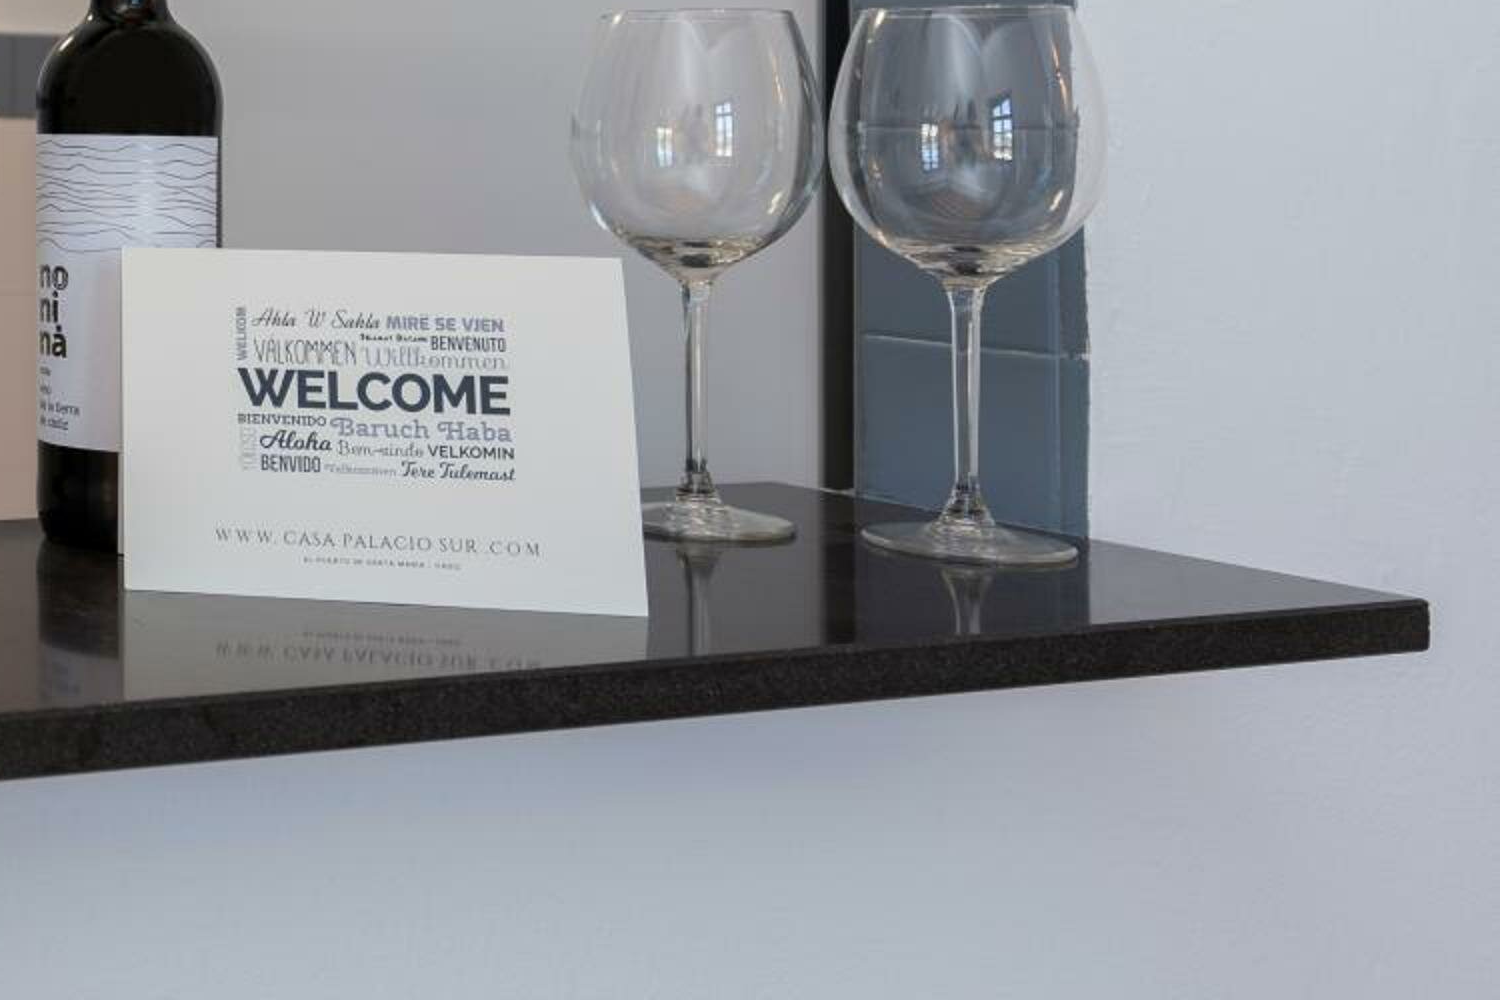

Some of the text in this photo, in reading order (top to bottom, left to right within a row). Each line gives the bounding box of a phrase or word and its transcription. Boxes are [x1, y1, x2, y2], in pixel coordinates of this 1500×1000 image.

[434, 317, 460, 332] SE
[430, 335, 507, 352] BENVENUTO
[237, 367, 511, 416] WELCOME
[237, 413, 327, 427] BIENVENIDO
[329, 417, 512, 443] Baruch Haba
[259, 429, 333, 452] Aloha
[427, 444, 515, 460] VELKOMIN
[260, 454, 322, 473] BENVIDO
[283, 530, 336, 548] CASA
[342, 533, 432, 551] PALACIO
[439, 537, 478, 553] SUR
